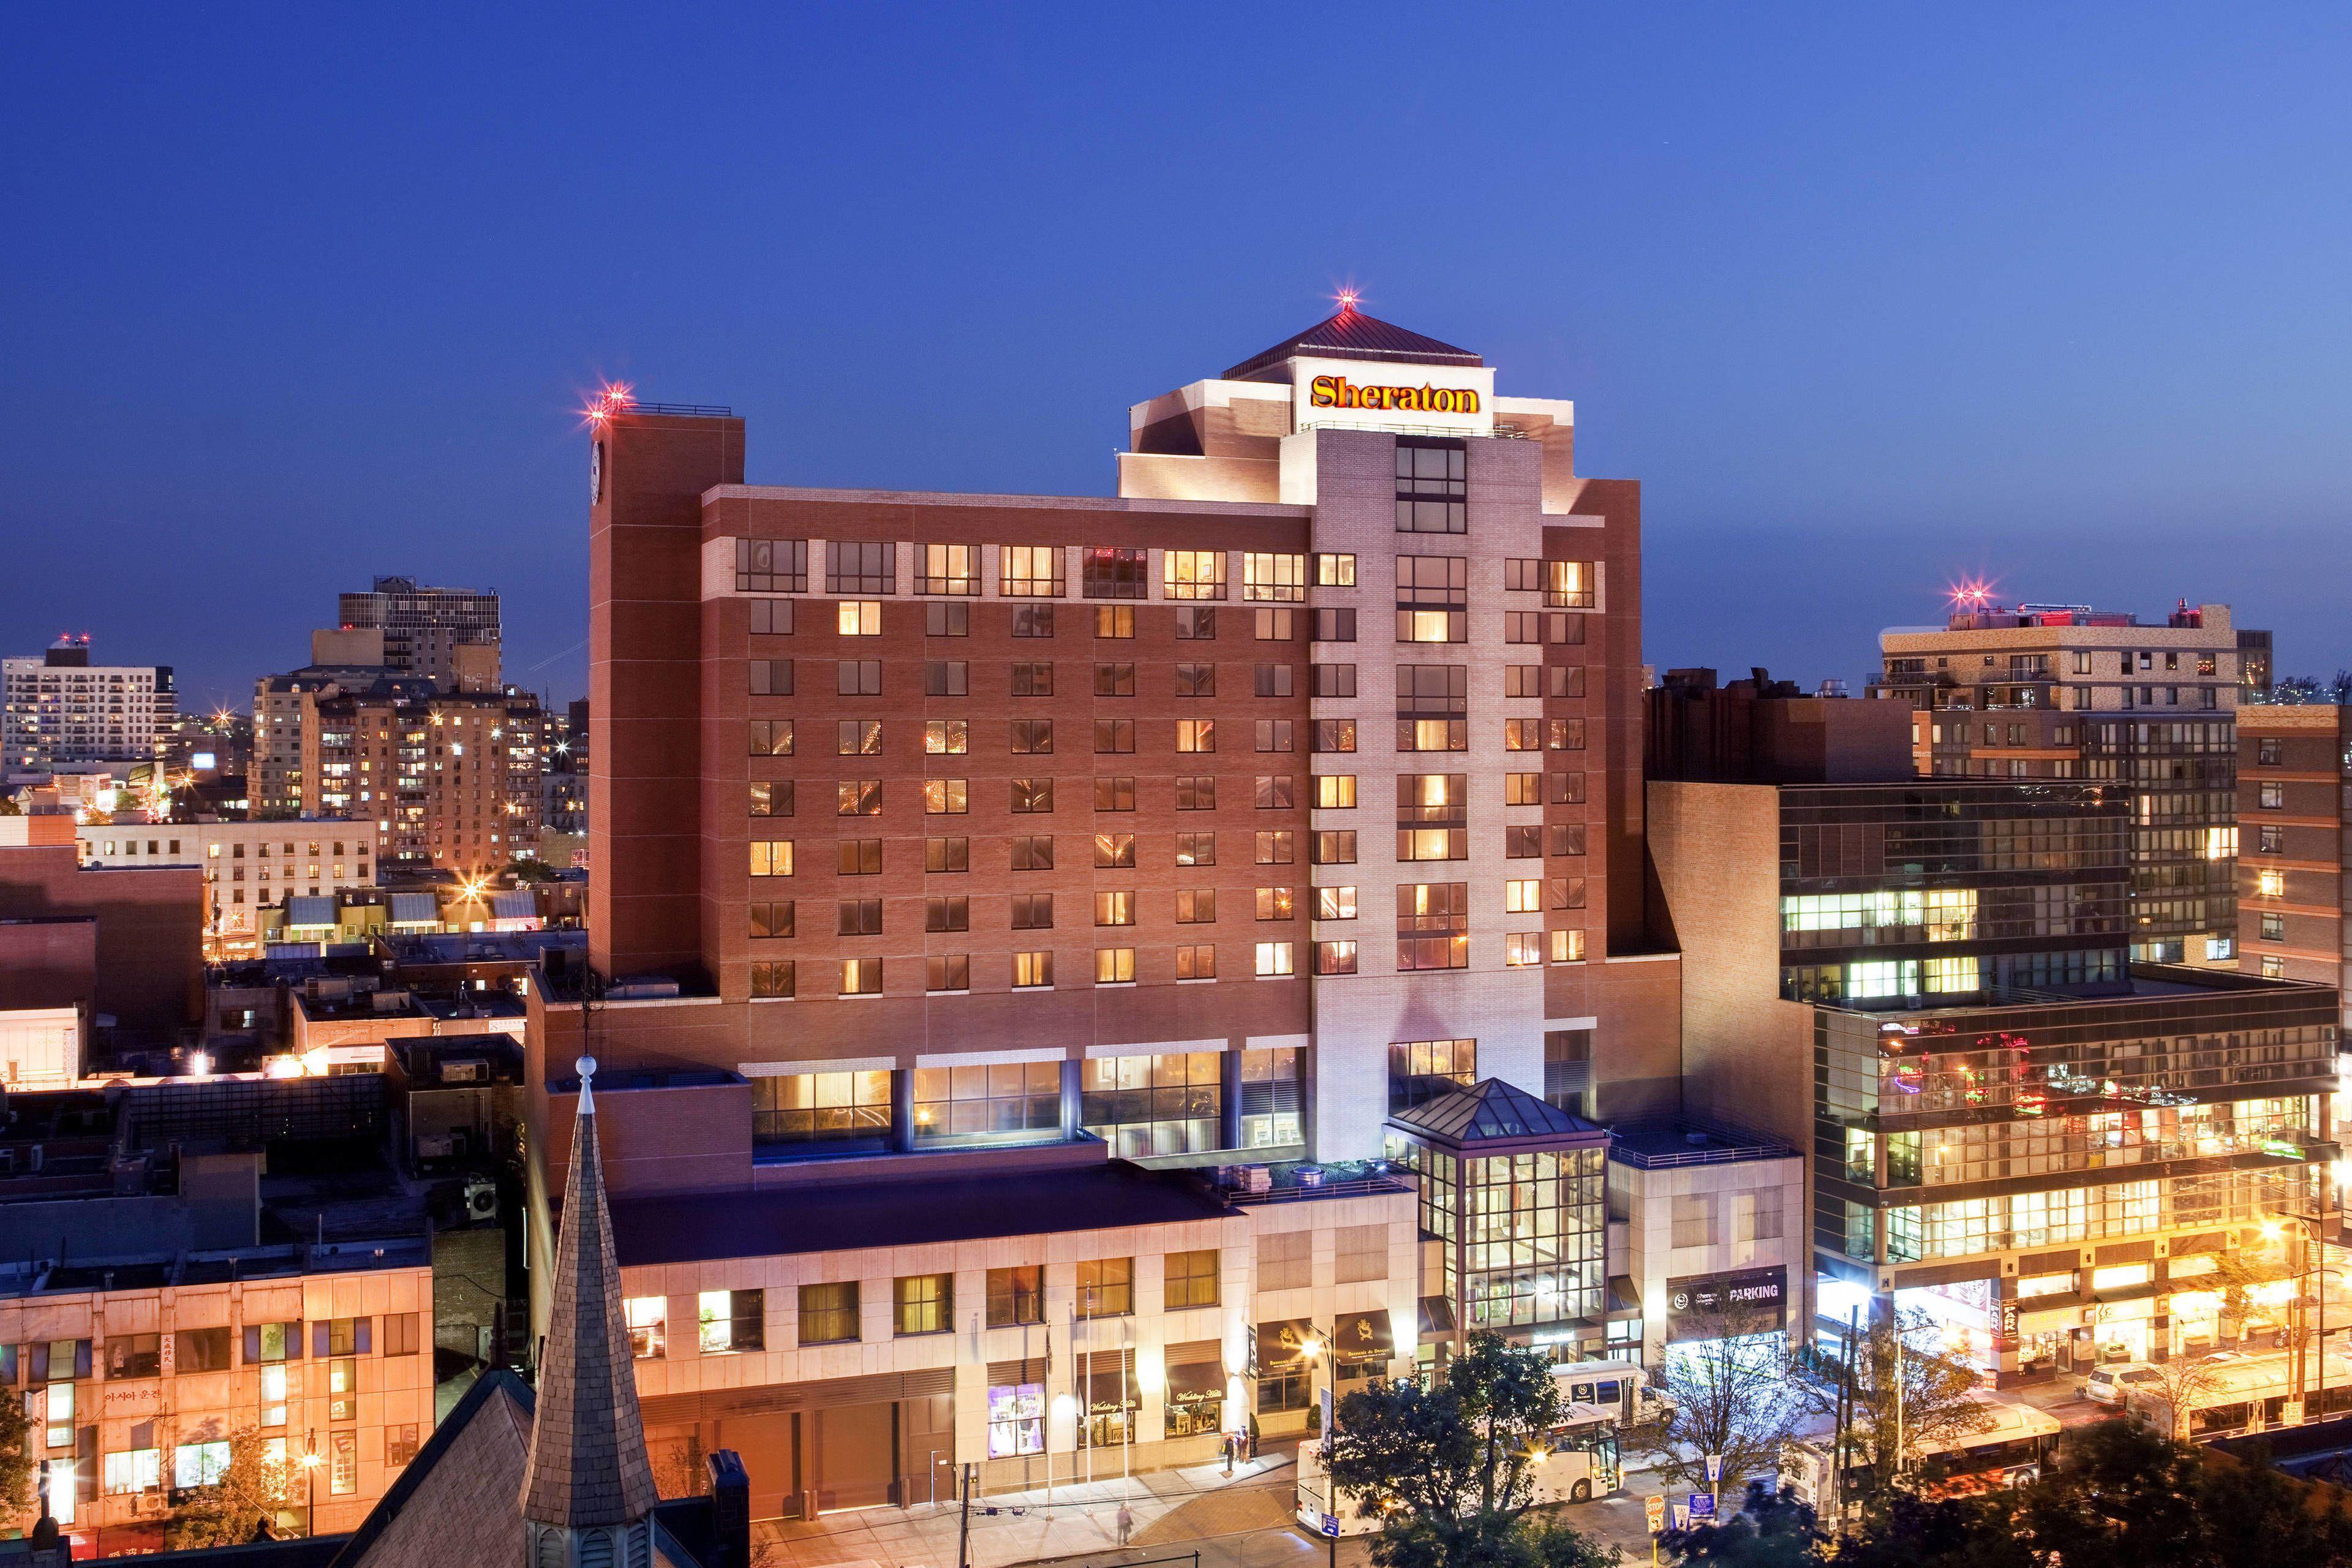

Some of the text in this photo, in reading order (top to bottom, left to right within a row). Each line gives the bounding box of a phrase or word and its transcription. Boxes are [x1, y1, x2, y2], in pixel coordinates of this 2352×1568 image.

[1311, 375, 1480, 413] Sheraton
[1730, 1284, 1778, 1302] PARKING
[2004, 1306, 2016, 1332] PARK
[105, 1391, 135, 1401] 아시아
[1177, 1391, 1205, 1402] Wedding
[1090, 1401, 1118, 1412] Wedding
[1648, 1502, 1664, 1512] STOP
